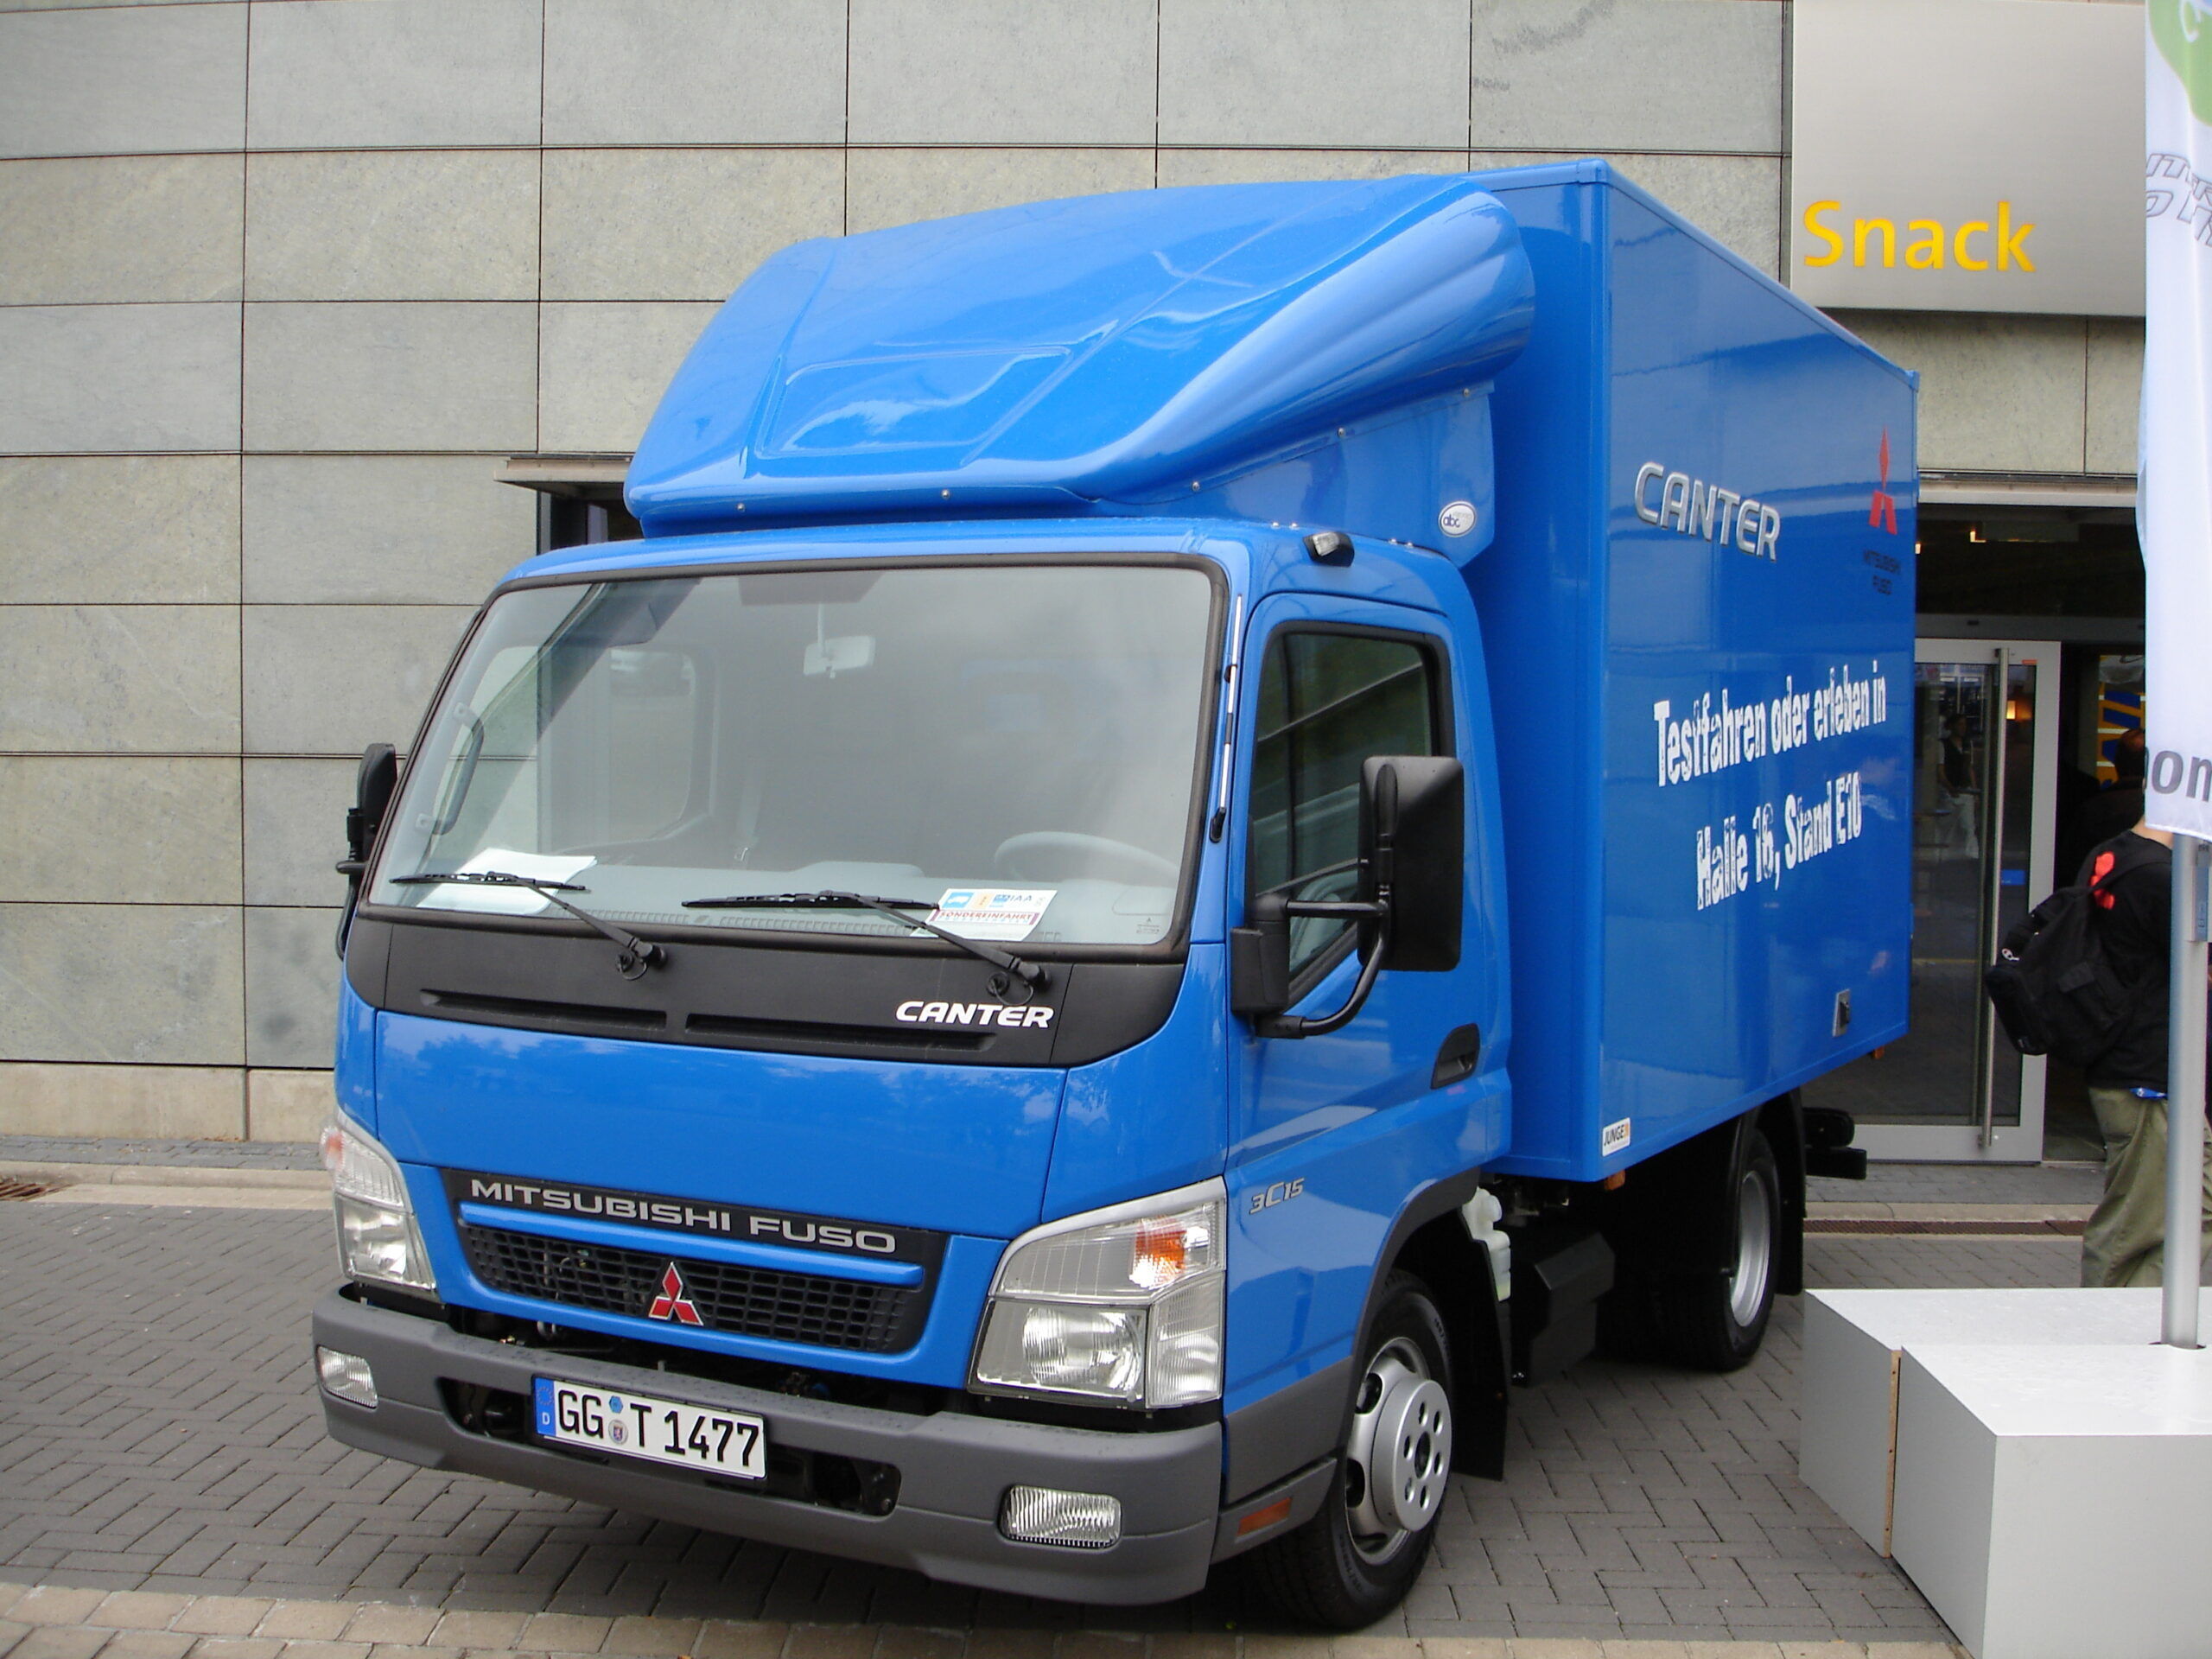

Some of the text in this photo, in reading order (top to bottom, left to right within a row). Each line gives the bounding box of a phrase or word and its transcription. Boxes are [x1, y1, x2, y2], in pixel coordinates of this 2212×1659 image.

[1803, 200, 2036, 272] Snack
[1634, 461, 1781, 562] CANTER
[1653, 659, 1887, 787] Testfahren oder erleben in
[1696, 815, 1749, 911] Halle
[1784, 780, 1833, 869] Stand
[1835, 772, 1862, 845] E10
[940, 912, 1033, 920] SONDEREINFAHRT
[895, 1001, 1054, 1029] CANTER
[471, 1179, 896, 1254] MITSUBISHI FUSO
[1249, 1177, 1305, 1215] 3C15
[542, 1411, 550, 1425] D
[558, 1389, 760, 1466] GG T 1477
